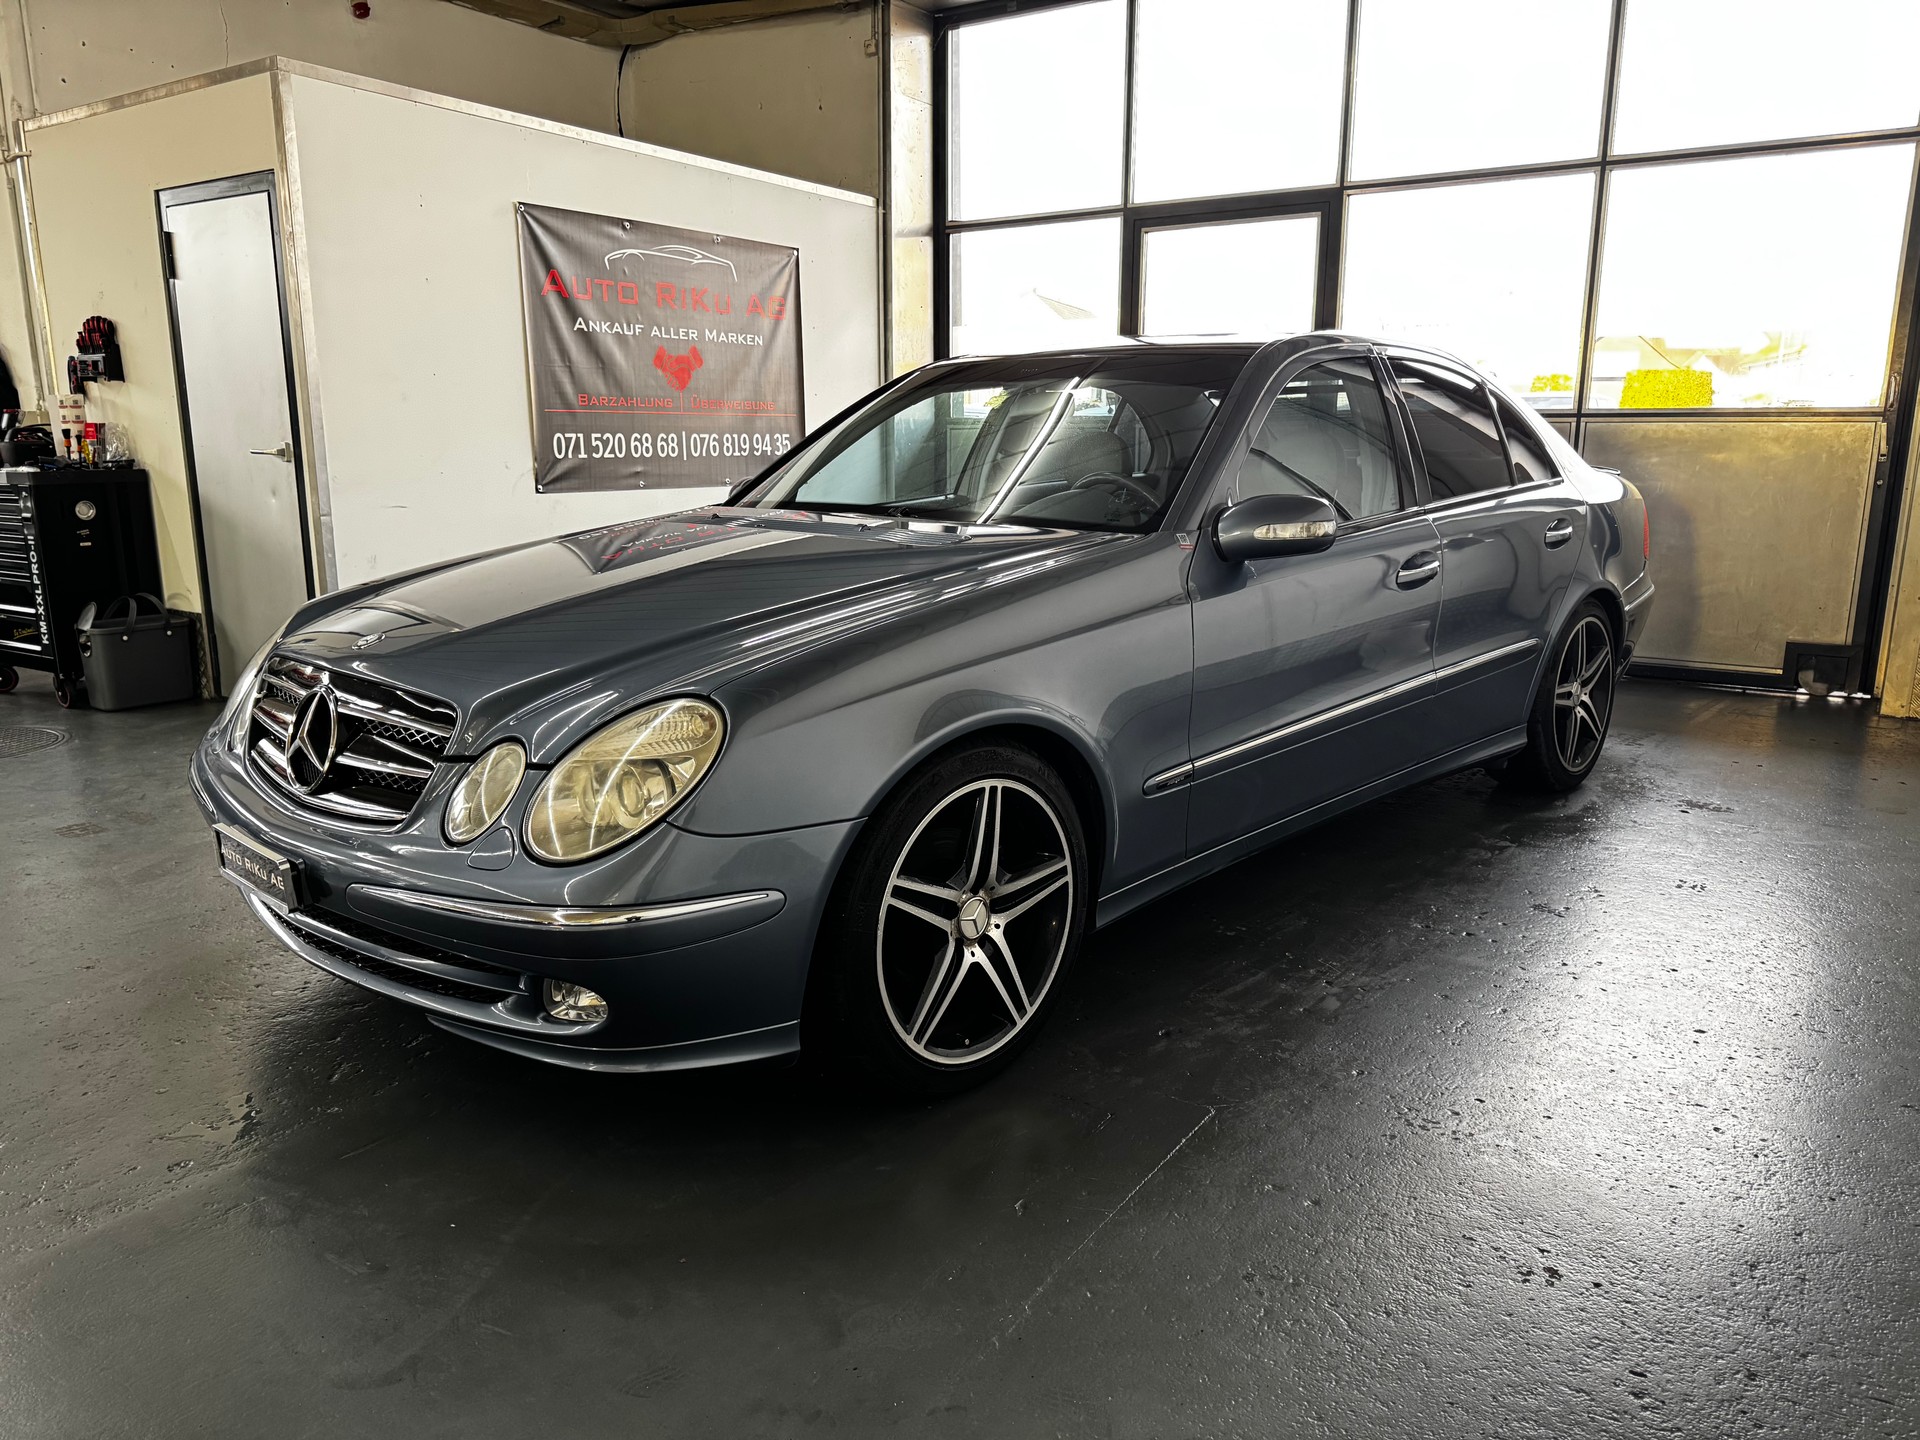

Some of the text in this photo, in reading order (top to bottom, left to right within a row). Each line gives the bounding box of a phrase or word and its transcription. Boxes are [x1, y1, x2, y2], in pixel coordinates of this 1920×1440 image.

[541, 269, 639, 305] AUTO
[745, 293, 786, 321] AG
[573, 317, 763, 346] ANKAUF ALLER MARKEN
[578, 393, 776, 411] BARZAHLUNG ÜBERWEISUNG
[553, 432, 791, 459] 071 520 68 68 076 819 94 35
[221, 843, 285, 890] AUTO RIKU AG
